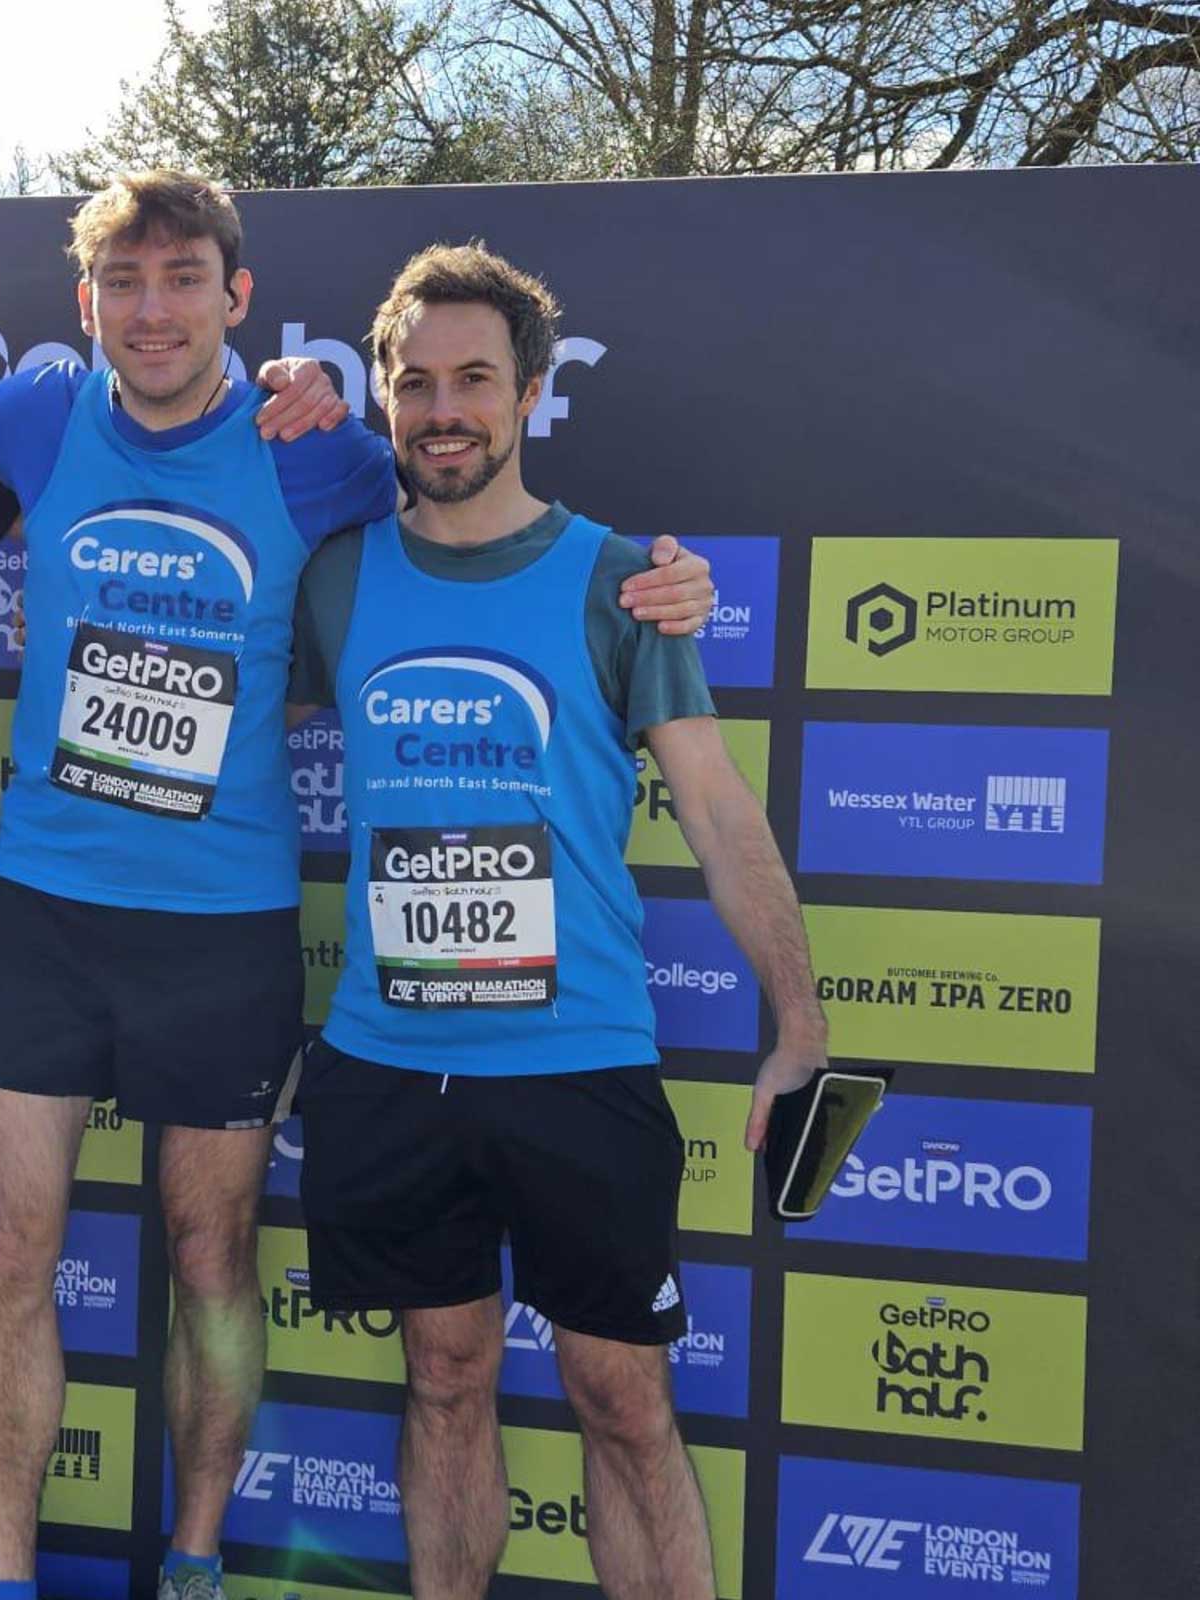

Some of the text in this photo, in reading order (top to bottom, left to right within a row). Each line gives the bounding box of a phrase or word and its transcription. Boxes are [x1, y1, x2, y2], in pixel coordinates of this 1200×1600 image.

[70, 537, 204, 580] Carers'
[100, 579, 235, 623] Centre
[926, 592, 1076, 619] Platinum
[117, 621, 155, 635] North
[159, 625, 186, 637] East
[926, 628, 1075, 644] MOTOR GROUP
[82, 642, 223, 699] GetPRO
[366, 690, 503, 725] Carers'
[81, 695, 197, 756] 24009
[395, 734, 537, 770] Centre
[90, 781, 131, 801] EVENTS
[92, 771, 139, 792] LONDON
[139, 782, 204, 805] MARATHON
[413, 775, 455, 789] North
[458, 776, 487, 789] East
[828, 789, 977, 811] Wessex Water
[899, 816, 975, 830] YTL GROUP
[385, 844, 535, 880] GetPRO
[402, 900, 517, 944] 10482
[421, 981, 473, 992] LONDON
[474, 978, 546, 991] MARATHON
[887, 967, 937, 979] BUTCOMBE
[940, 970, 982, 981] BREWING
[421, 991, 466, 1003] EVENTS
[816, 976, 1072, 1013] GORAM IPA ZERO
[829, 1153, 1052, 1211] GetPRO
[879, 1303, 990, 1332] GetPRO
[871, 1330, 989, 1382] bath
[293, 1456, 375, 1480] LONDON
[293, 1472, 400, 1499] MARATHON
[293, 1489, 363, 1511] EVENTS
[509, 1487, 587, 1538] Get
[924, 1523, 1018, 1549] LONDON
[924, 1541, 1051, 1571] MARATHON
[924, 1557, 1005, 1583] EVENTS
